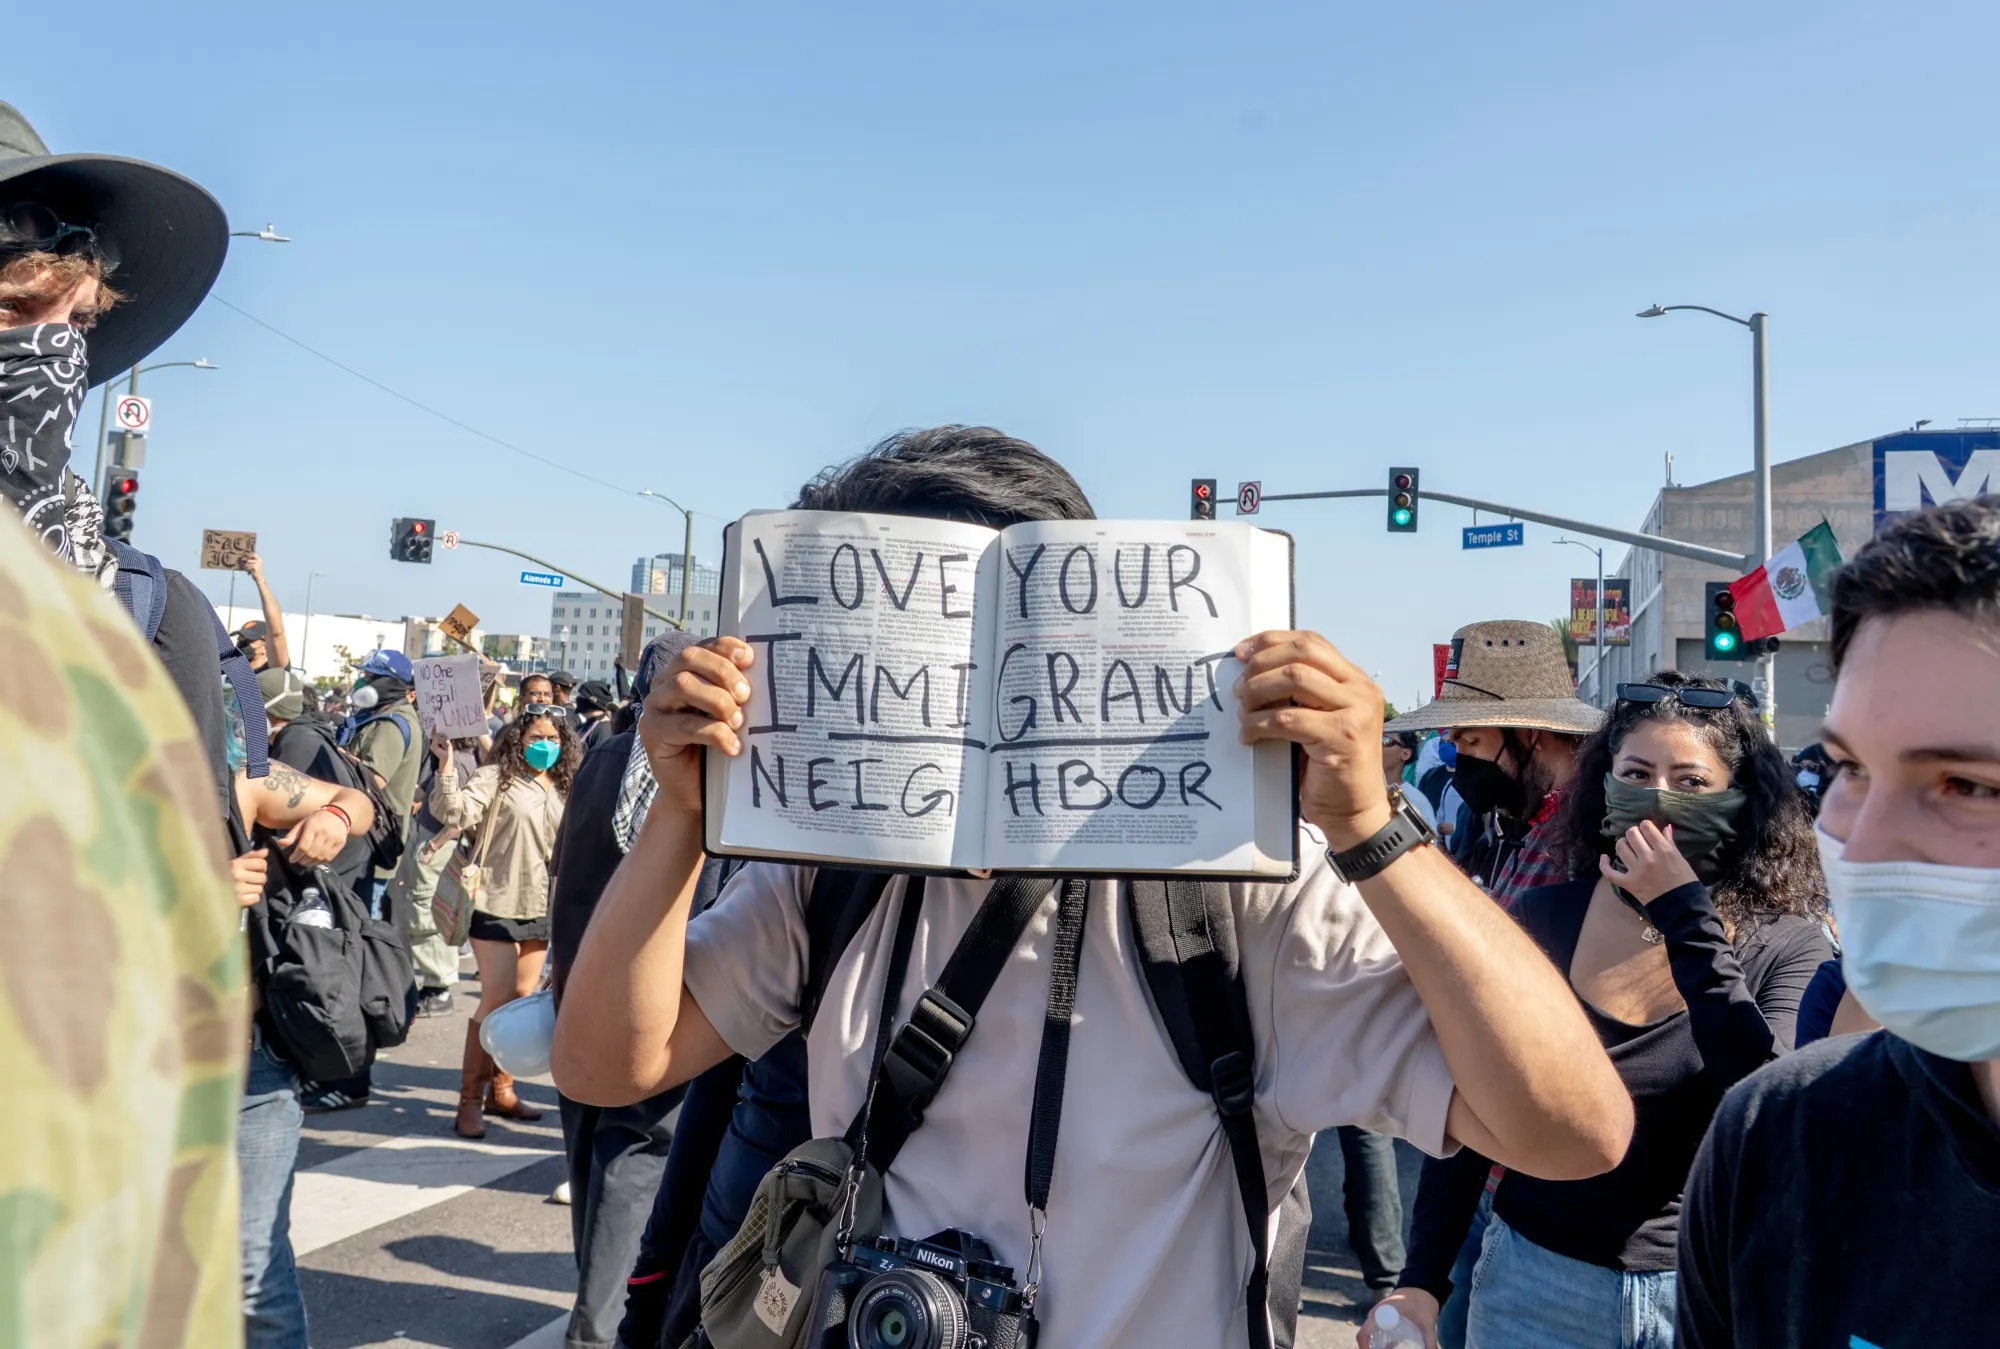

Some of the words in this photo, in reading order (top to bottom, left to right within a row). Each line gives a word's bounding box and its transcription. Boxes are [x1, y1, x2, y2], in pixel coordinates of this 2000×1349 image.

[1468, 531, 1502, 545] Temple
[1506, 529, 1518, 541] St
[524, 574, 552, 584] Alameda
[552, 577, 560, 586] St
[754, 538, 971, 619] LOVE
[1006, 542, 1218, 619] YOUR
[433, 664, 454, 678] One
[432, 680, 446, 690] IS
[917, 1249, 954, 1270] Nikon
